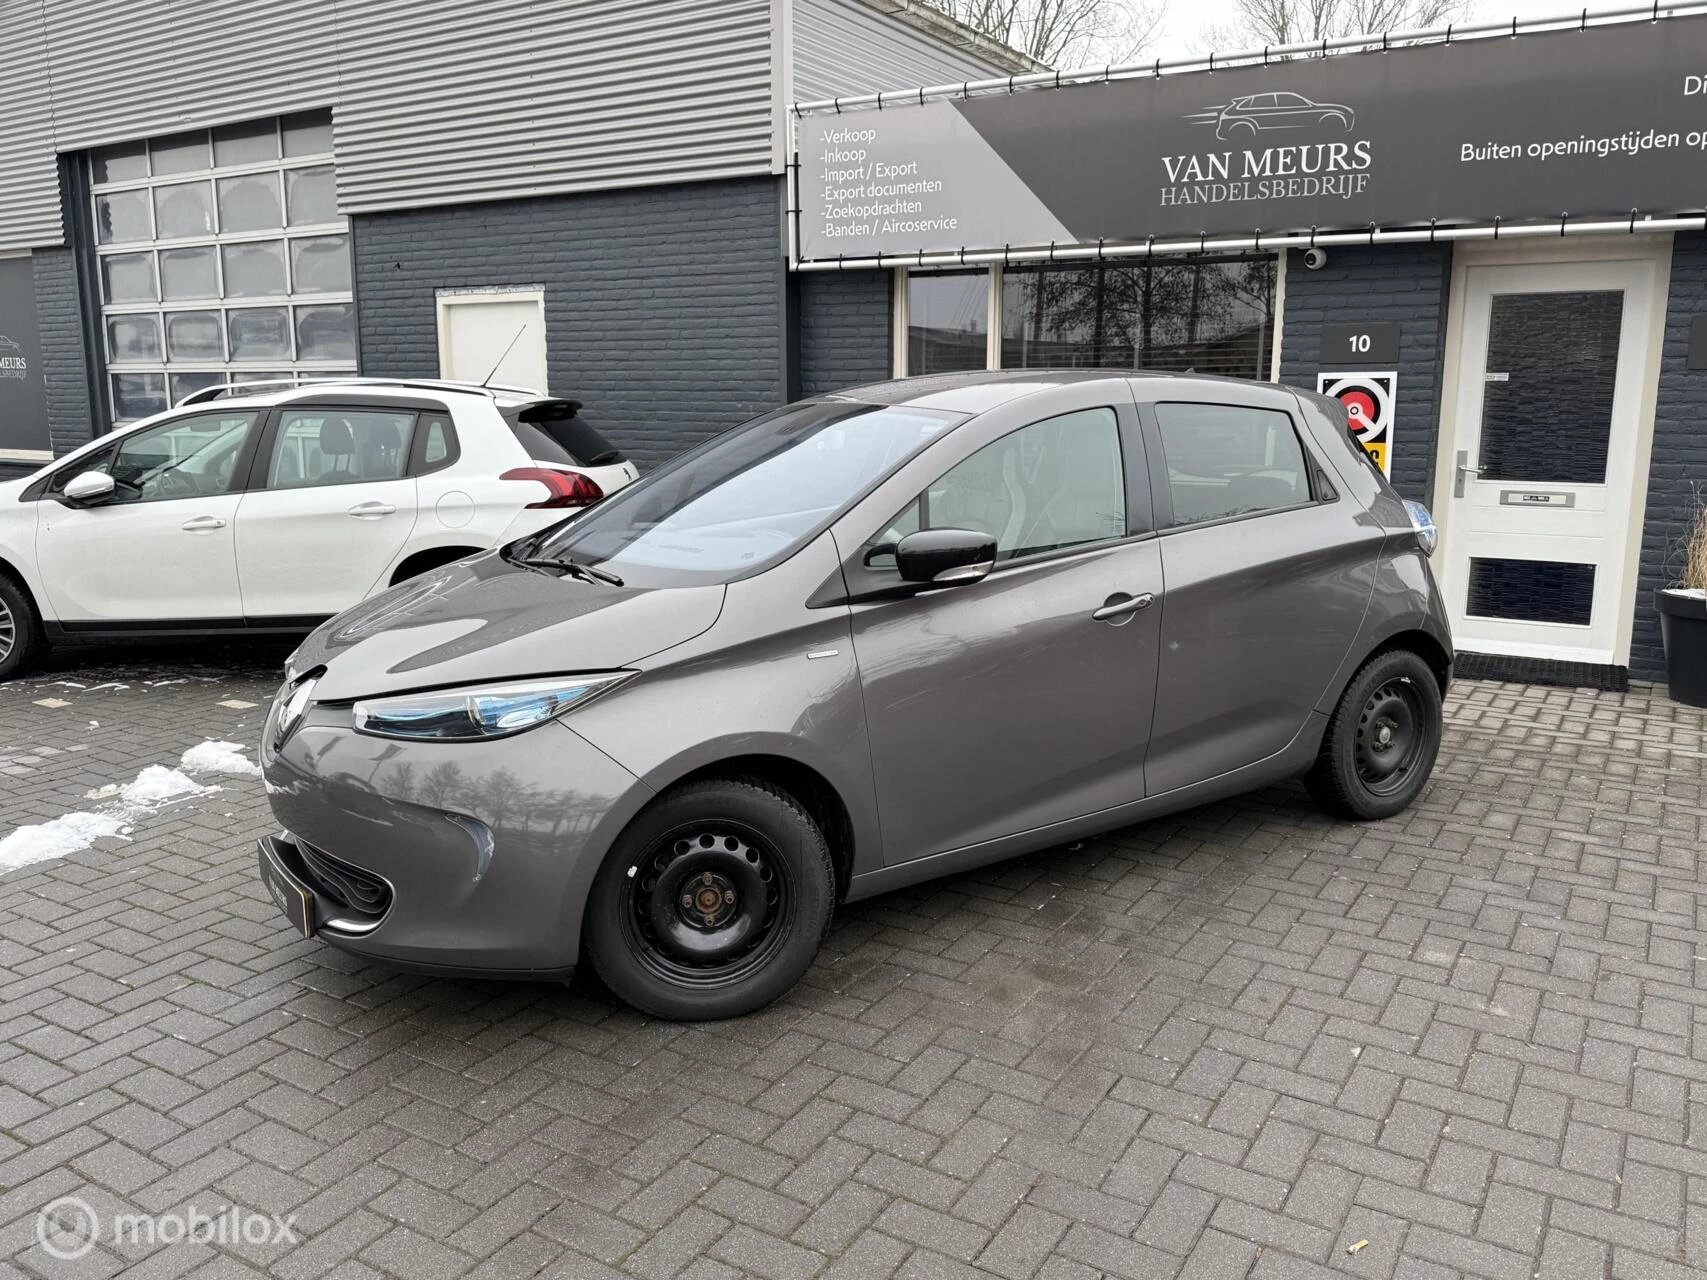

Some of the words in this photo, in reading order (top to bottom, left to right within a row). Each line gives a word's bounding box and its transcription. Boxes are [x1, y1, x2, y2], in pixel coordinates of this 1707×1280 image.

[819, 127, 876, 146] -Verkoop
[1460, 141, 1522, 162] Buiten
[1527, 128, 1680, 161] openingstijden
[819, 147, 867, 165] -Inkoop
[1161, 151, 1233, 184] VAN
[1240, 140, 1373, 178] MEURS
[820, 167, 864, 185] -Import
[875, 161, 918, 180] Export
[820, 184, 865, 203] -Export
[866, 179, 943, 197] documenten
[1159, 173, 1371, 206] HANDELSBEDRIJF
[821, 198, 923, 220] -Zoekopdrachten
[821, 220, 870, 238] -Banden
[882, 215, 958, 233] Aircoservice
[1349, 334, 1371, 353] 10
